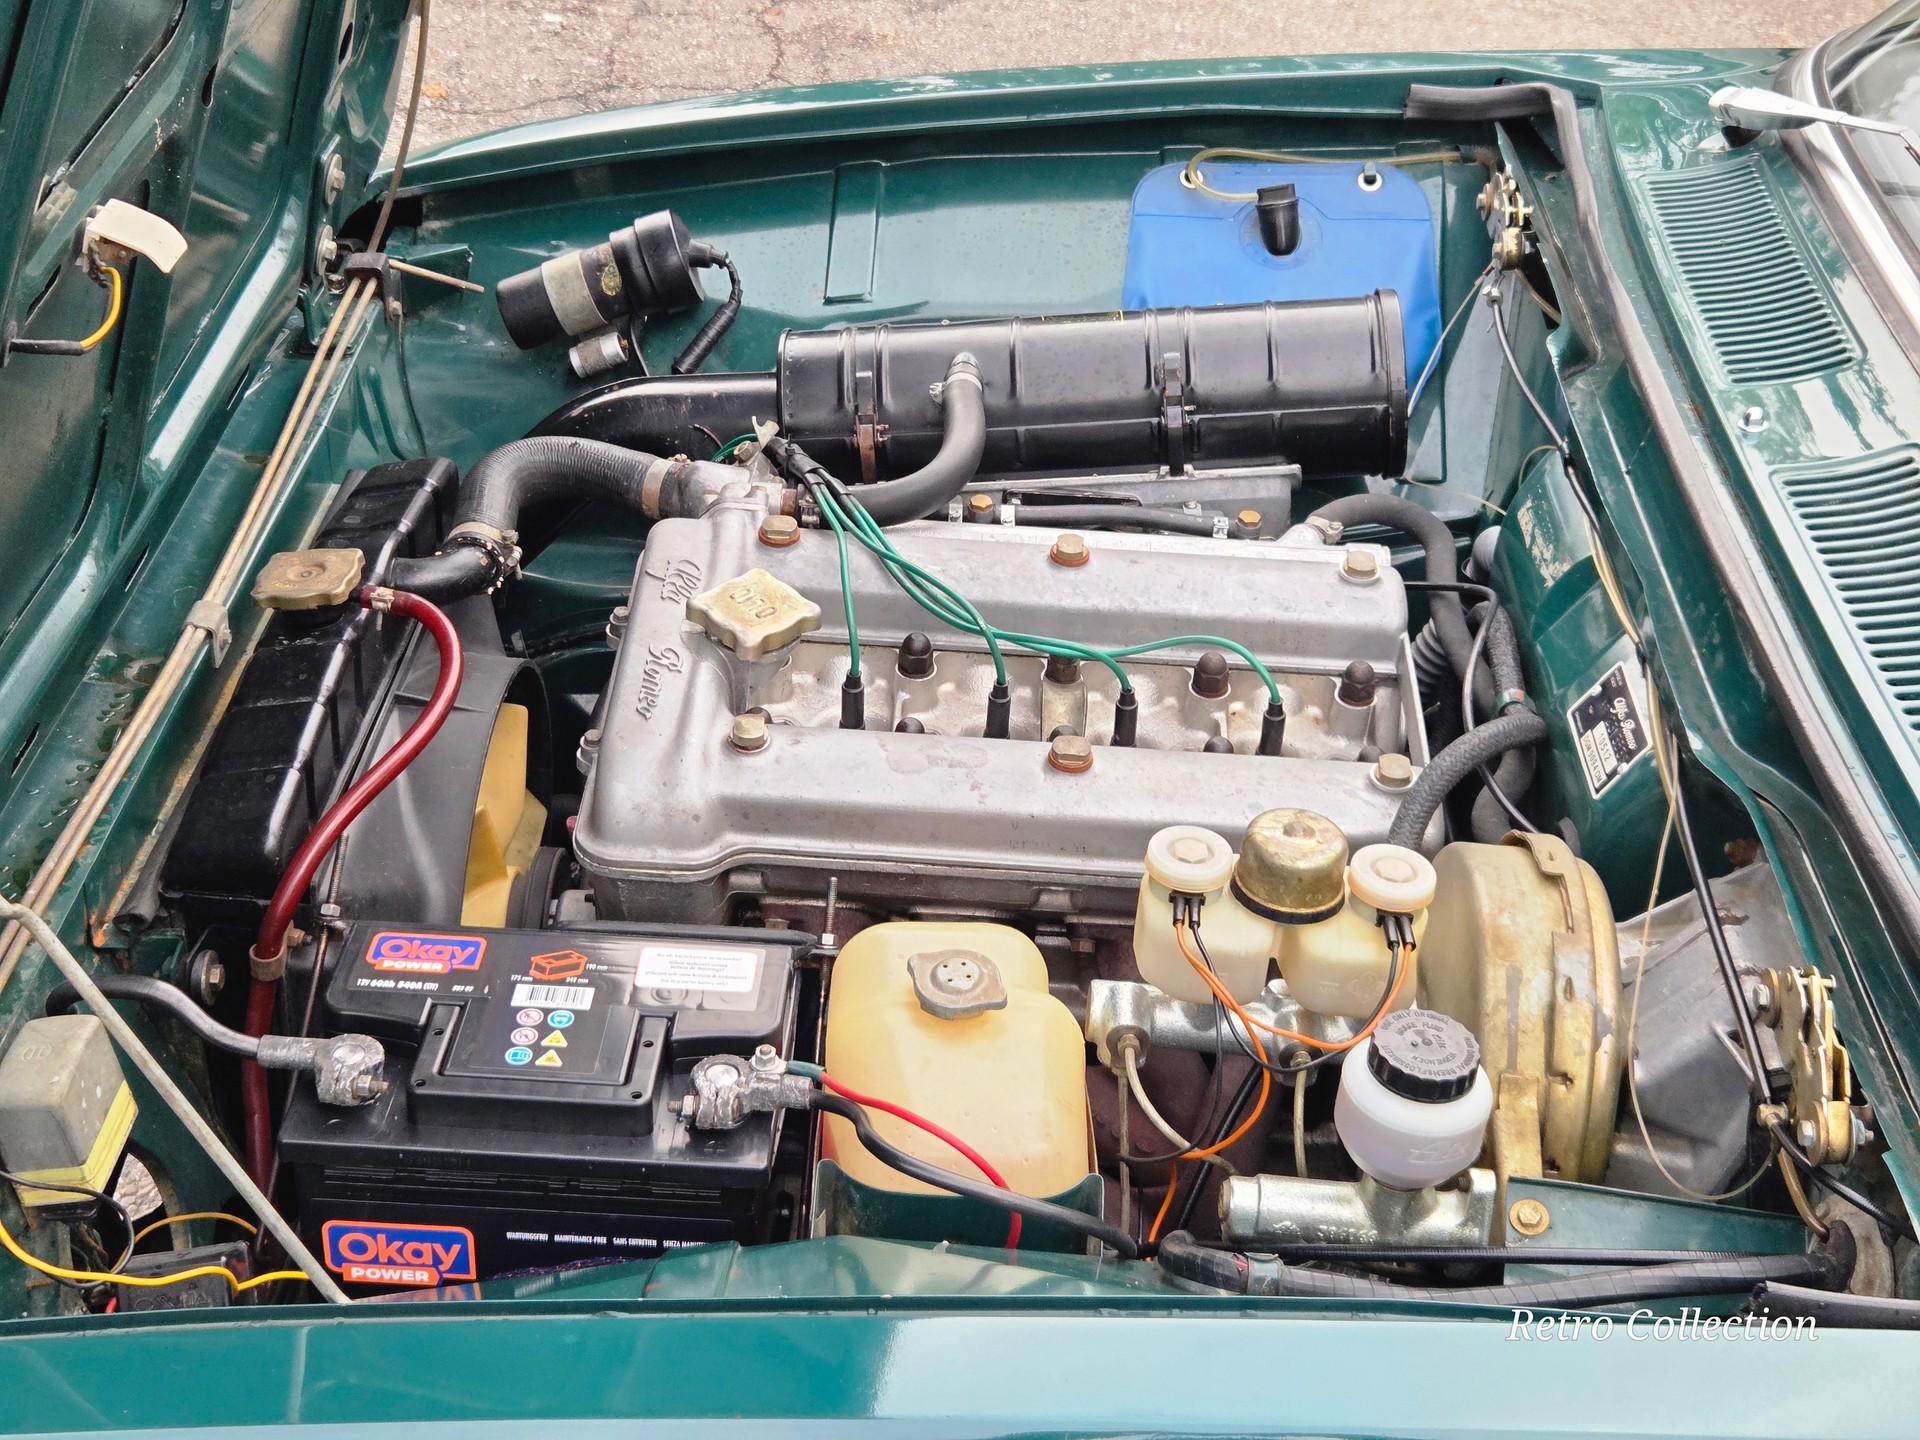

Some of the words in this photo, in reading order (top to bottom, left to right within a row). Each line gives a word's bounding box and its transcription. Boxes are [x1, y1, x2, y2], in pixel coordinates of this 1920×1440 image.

[636, 644, 683, 721] Romeo
[1609, 696, 1630, 722] Alfa
[1619, 716, 1639, 751] Romeo
[1597, 732, 1612, 762] 10512
[381, 938, 475, 965] Okay
[382, 959, 443, 971] POWER
[1394, 1011, 1412, 1021] ONLY
[1395, 1021, 1418, 1037] BRAKE
[1422, 1021, 1444, 1033] FLUID
[338, 1232, 462, 1271] Okay
[351, 1266, 430, 1282] POWER
